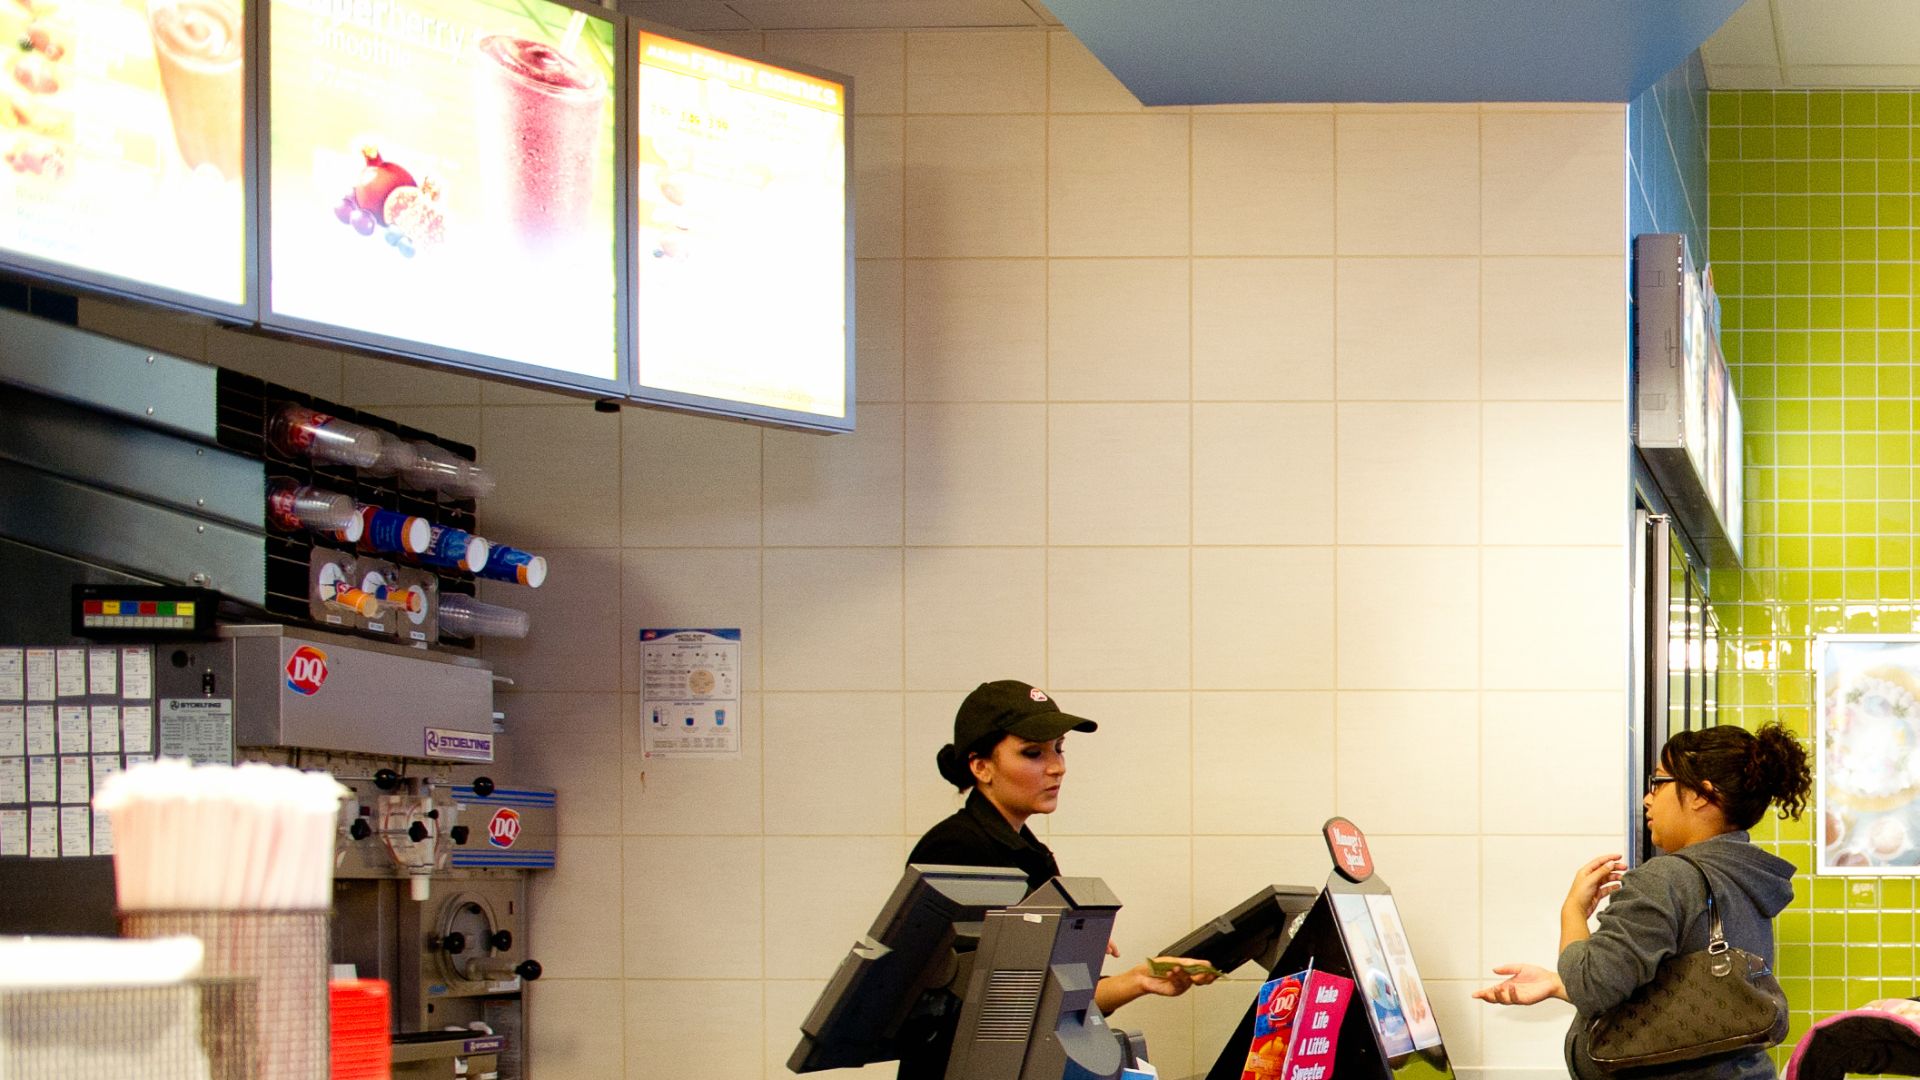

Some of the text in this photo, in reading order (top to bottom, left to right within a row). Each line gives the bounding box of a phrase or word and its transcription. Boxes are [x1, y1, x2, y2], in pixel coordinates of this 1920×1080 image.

[294, 656, 322, 686] DQ
[440, 736, 490, 750] STOELTING
[495, 818, 515, 840] DQ
[1274, 993, 1295, 1013] DQ
[1315, 985, 1339, 1003] Make
[1312, 1010, 1330, 1030] Life
[1298, 1036, 1330, 1056] A Little
[1290, 1062, 1326, 1080] Sweeter
